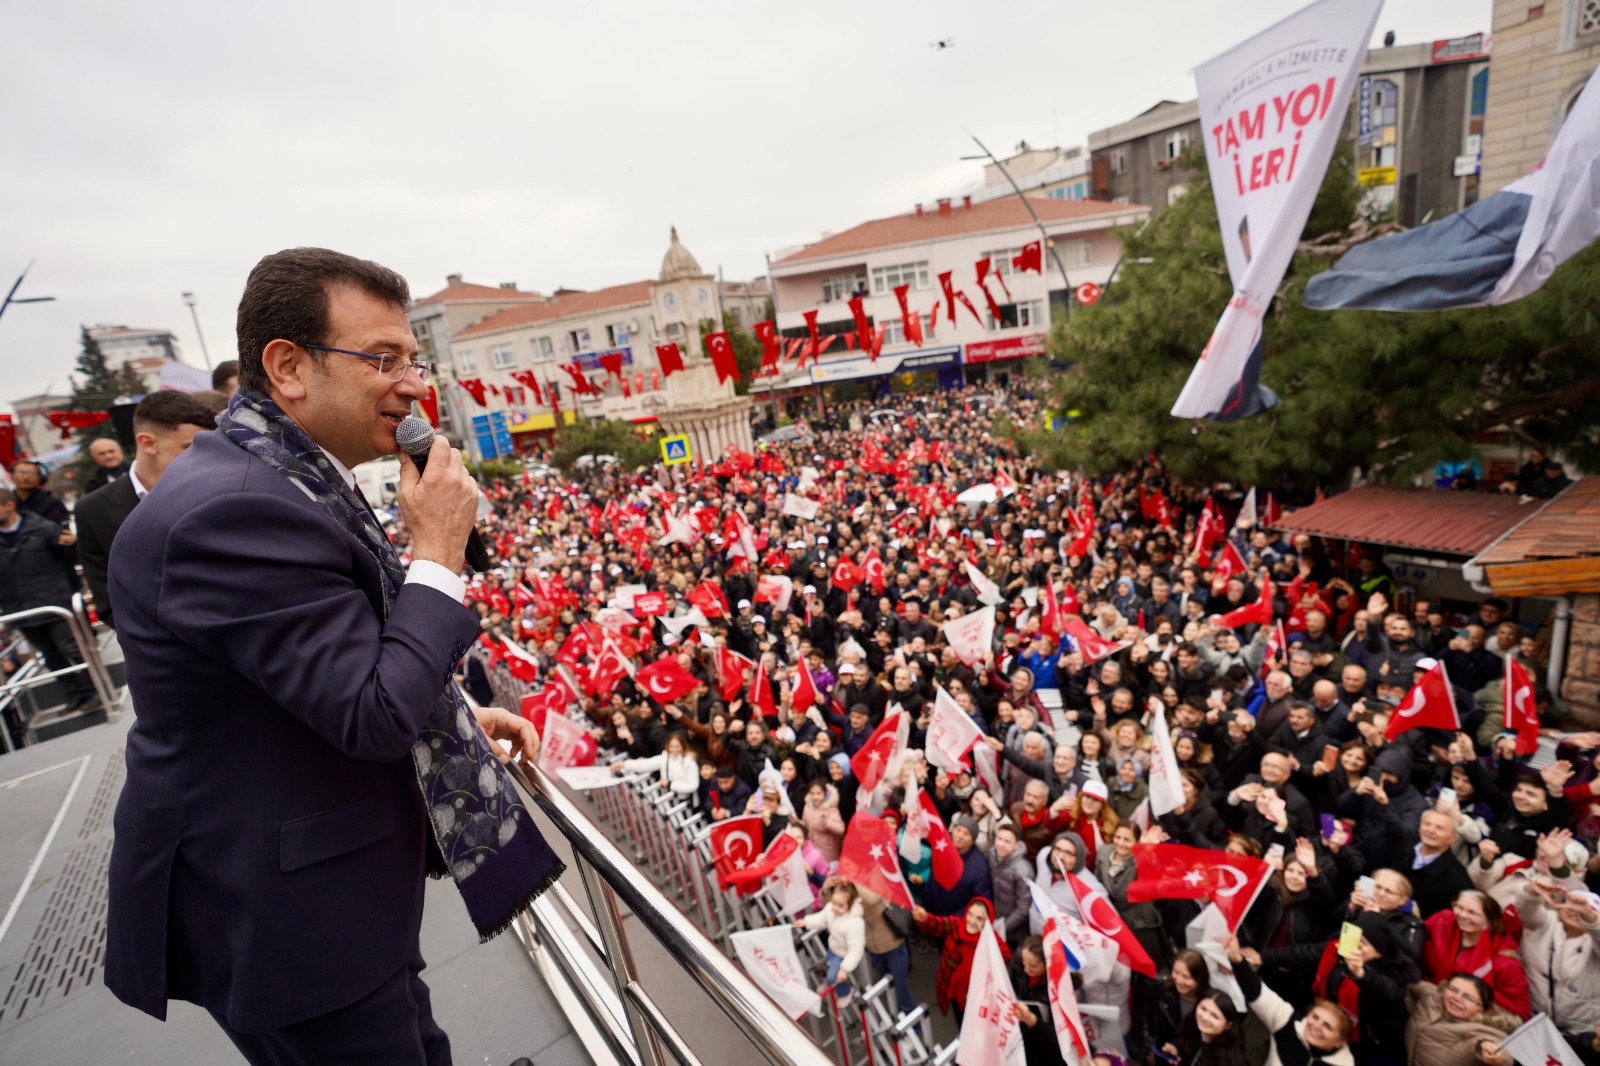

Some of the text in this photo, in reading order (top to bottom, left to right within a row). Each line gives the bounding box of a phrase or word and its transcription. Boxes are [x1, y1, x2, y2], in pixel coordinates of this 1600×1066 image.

[1277, 48, 1347, 66] HİZMETTE
[1212, 102, 1267, 158] TAM
[1232, 129, 1303, 196] İLERİ
